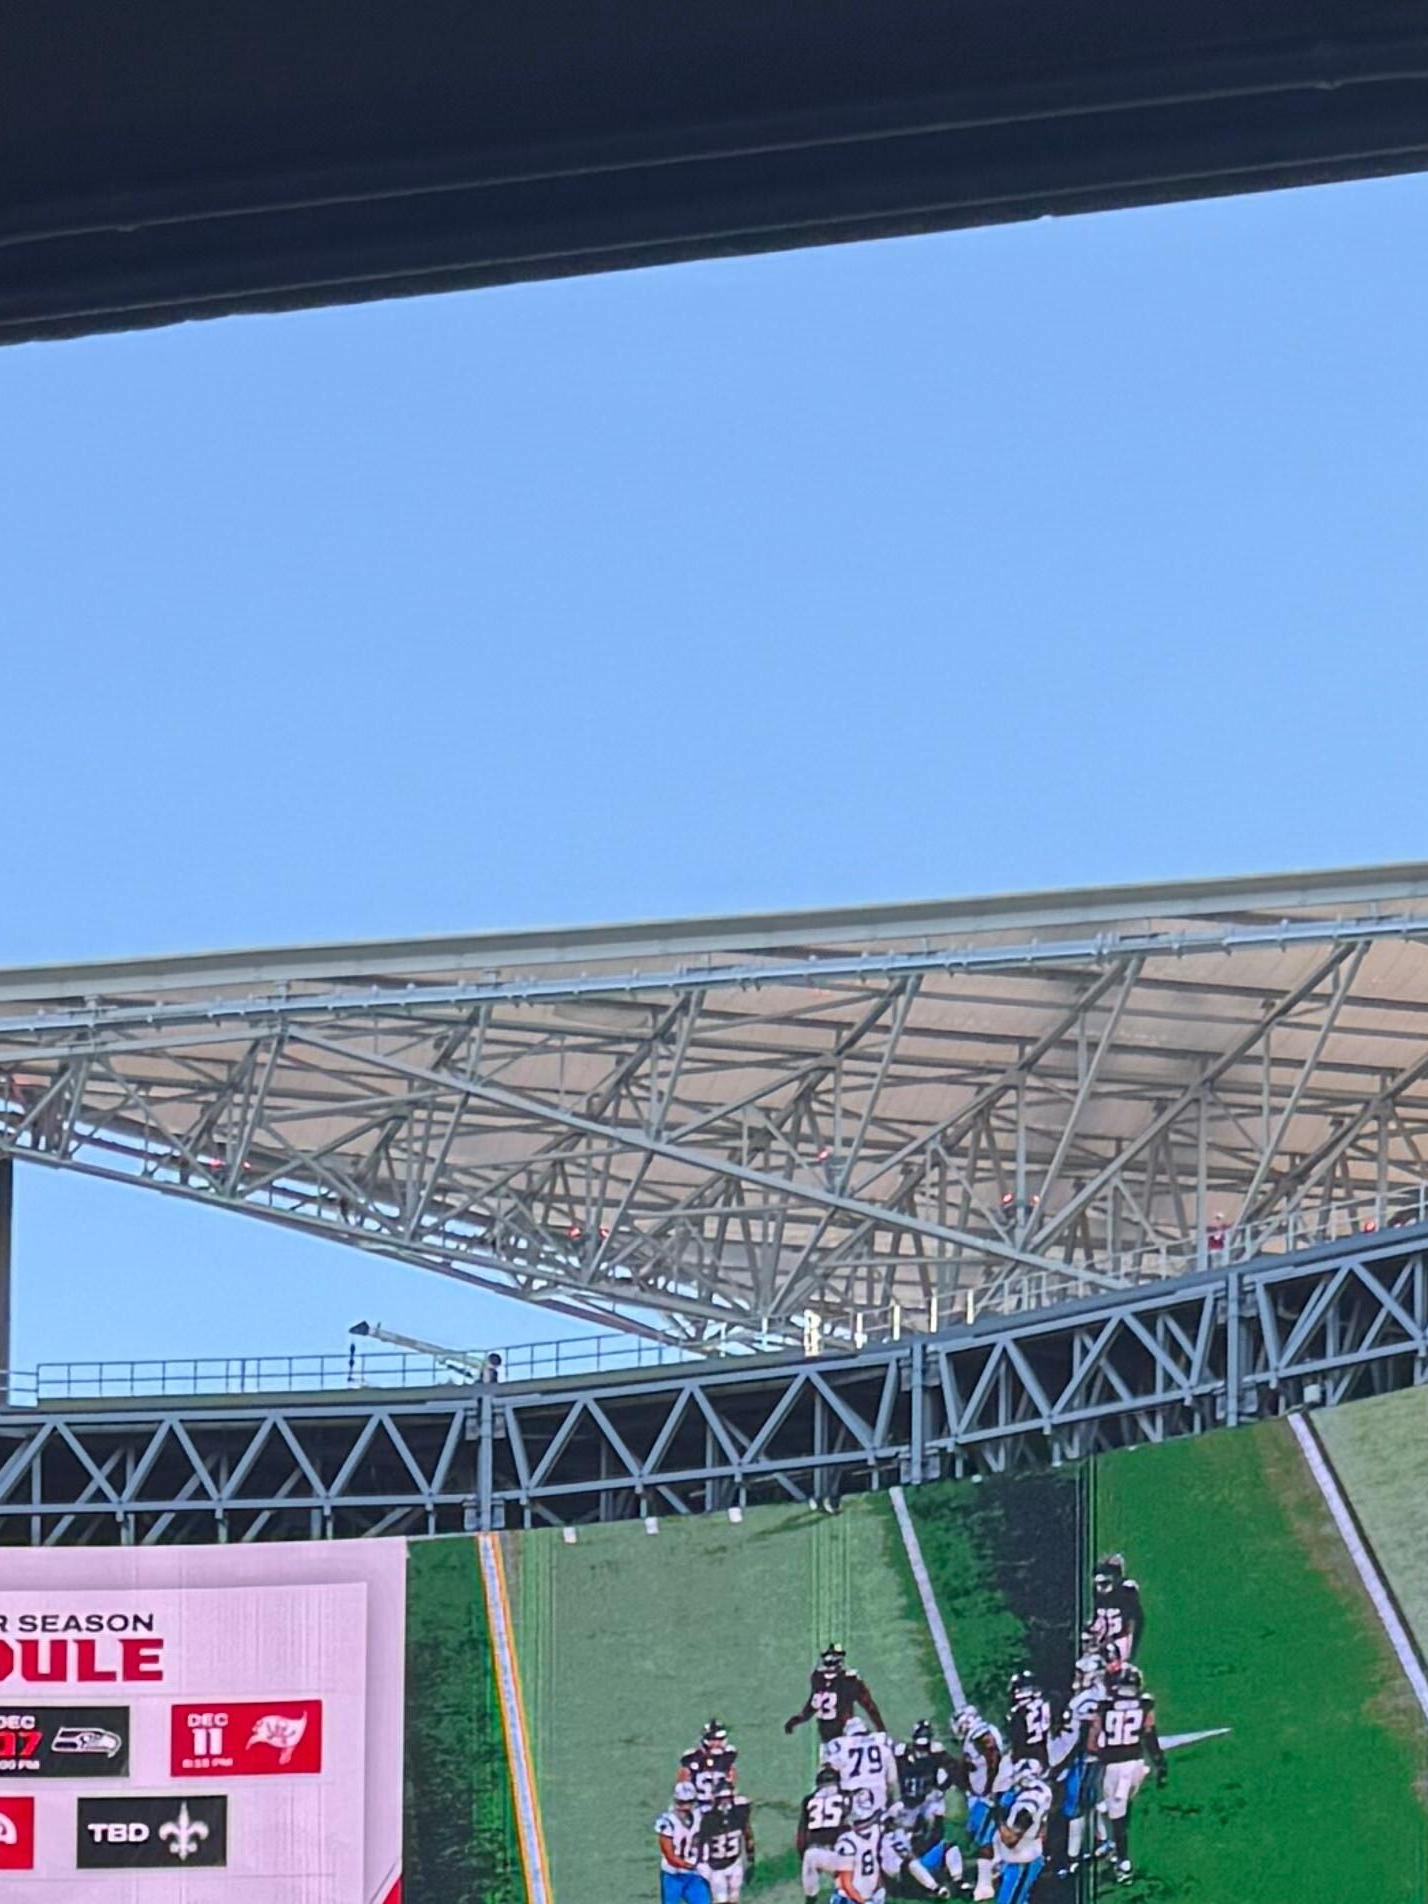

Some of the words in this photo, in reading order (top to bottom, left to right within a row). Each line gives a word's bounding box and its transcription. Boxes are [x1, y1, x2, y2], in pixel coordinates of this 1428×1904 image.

[17, 1612, 155, 1633] SEASON
[187, 1712, 229, 1728] DEC
[192, 1728, 224, 1756] 11
[849, 1746, 882, 1777] 79
[809, 1804, 843, 1830] 35
[87, 1822, 150, 1843] TBD
